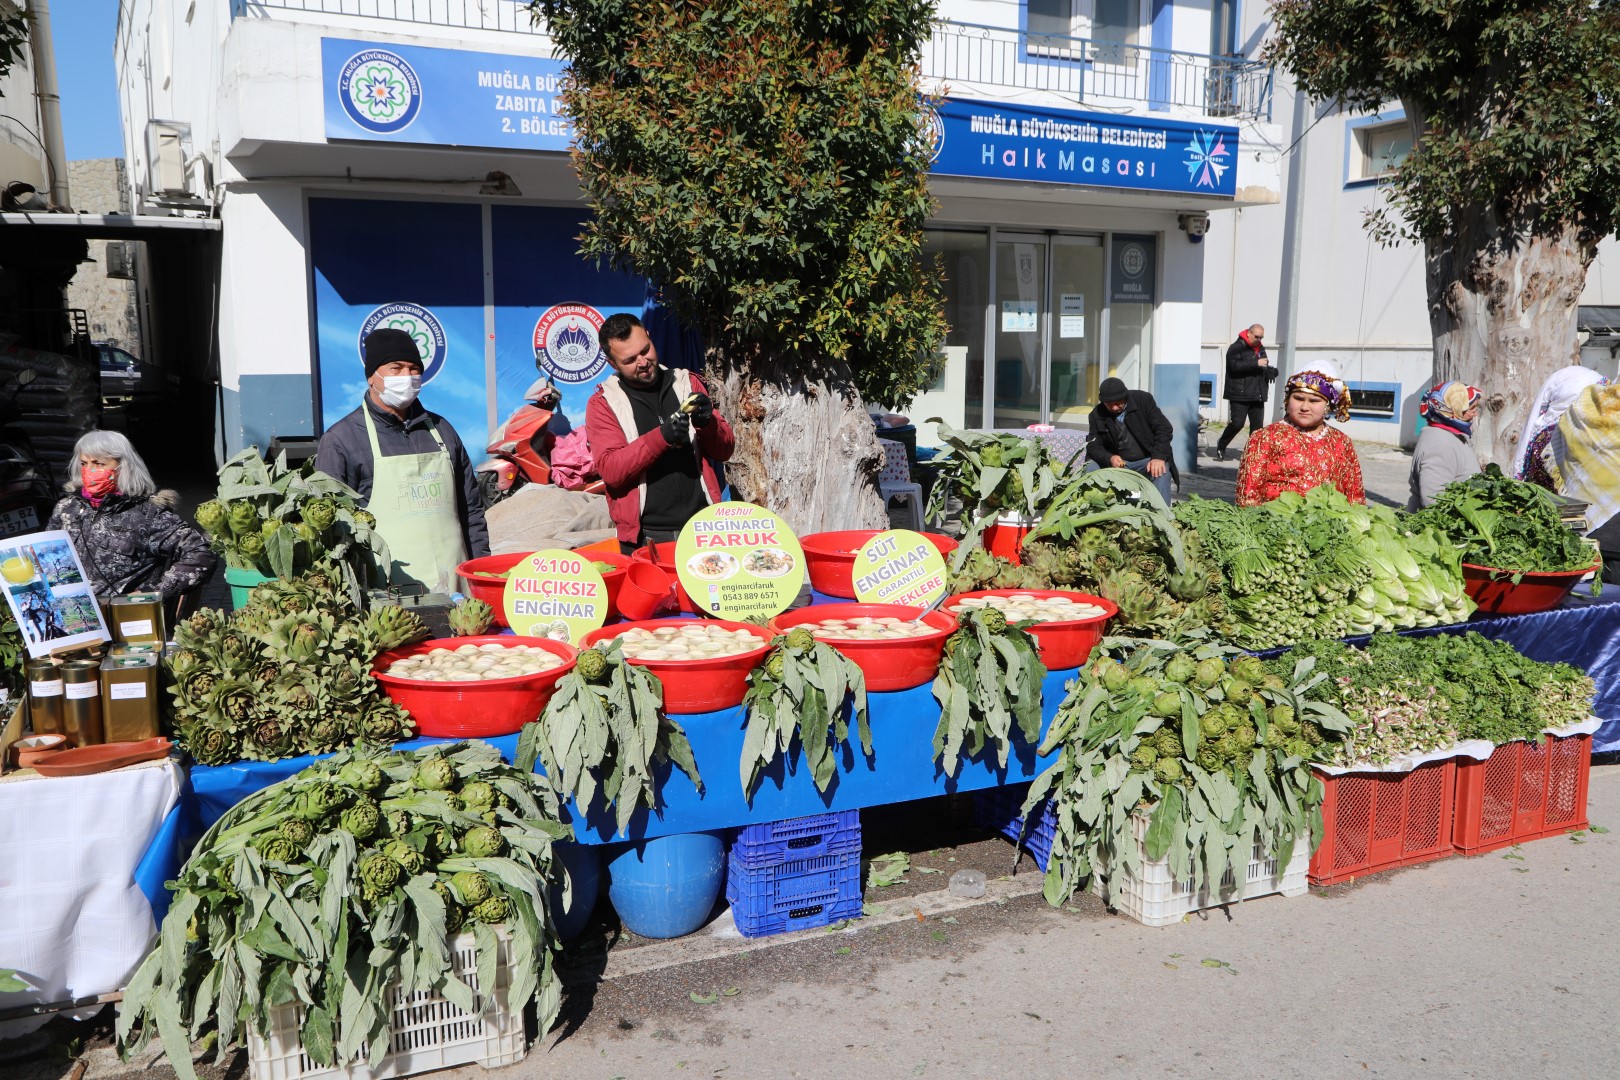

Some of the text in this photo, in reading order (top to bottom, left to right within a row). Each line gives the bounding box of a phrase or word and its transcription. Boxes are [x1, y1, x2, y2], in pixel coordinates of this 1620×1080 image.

[345, 58, 362, 77] MUĞLA
[361, 51, 400, 67] BÜYÜKŞEHİR
[399, 63, 419, 96] BELEDİYESİ
[478, 69, 531, 91] MUĞLA
[495, 94, 547, 114] ZABITA
[501, 117, 516, 133] 2.
[520, 115, 567, 136] BÖLGE
[970, 114, 1167, 150] MUĞLA BÜYÜKŞEHİR BELEDİYESİ
[981, 143, 1155, 178] Halk Masası
[364, 304, 445, 347] MUĞLA BÜYÜKŞEHİR BELEDİYESİ
[537, 321, 549, 345] MUĞLA
[546, 305, 587, 321] BÜYÜKŞEHİR
[552, 368, 580, 380] DAİRESİ
[19, 507, 35, 519] BZ
[714, 507, 755, 518] Meşhur
[8, 519, 29, 532] 571
[693, 518, 776, 532] ENGİNARCI
[695, 532, 780, 548] FARUK
[866, 536, 897, 563] SÜT
[532, 558, 582, 575] %100
[855, 545, 930, 593] ENGİNAR
[514, 578, 598, 598] KILÇIKSIZ
[721, 581, 775, 593] enginarcifaruk
[878, 565, 926, 598] GARANTİLİ
[722, 591, 780, 602] 0543 889 6571
[514, 599, 595, 618] ENGİNAR
[724, 601, 779, 613] enginarcifaruk
